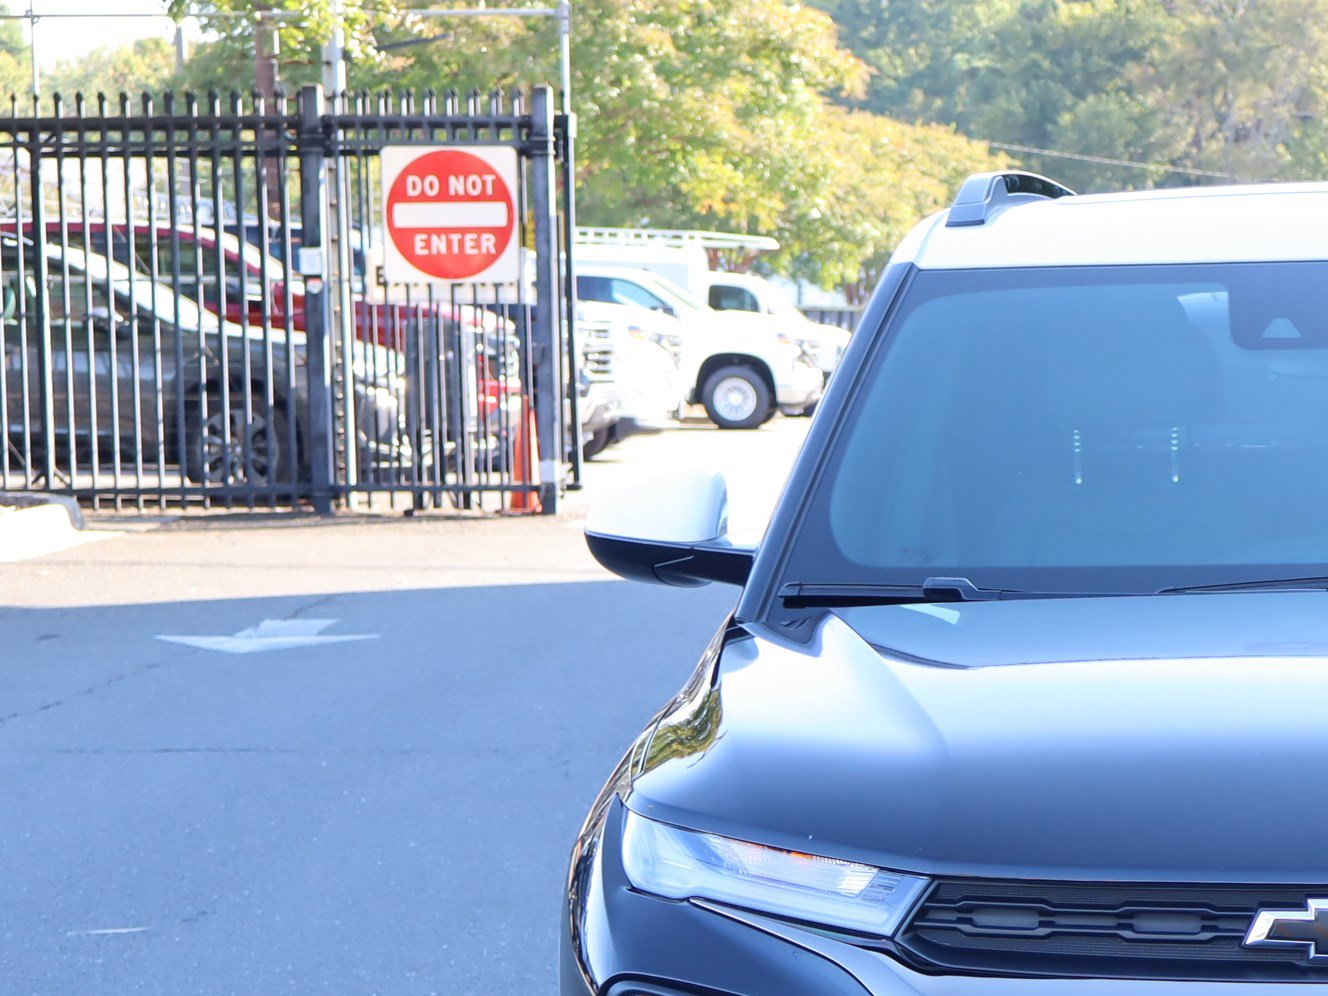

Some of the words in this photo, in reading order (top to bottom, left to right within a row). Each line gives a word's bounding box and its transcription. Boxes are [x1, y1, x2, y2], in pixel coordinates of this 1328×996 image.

[406, 174, 440, 197] DO
[448, 174, 497, 197] NOT
[413, 233, 497, 256] ENTER
